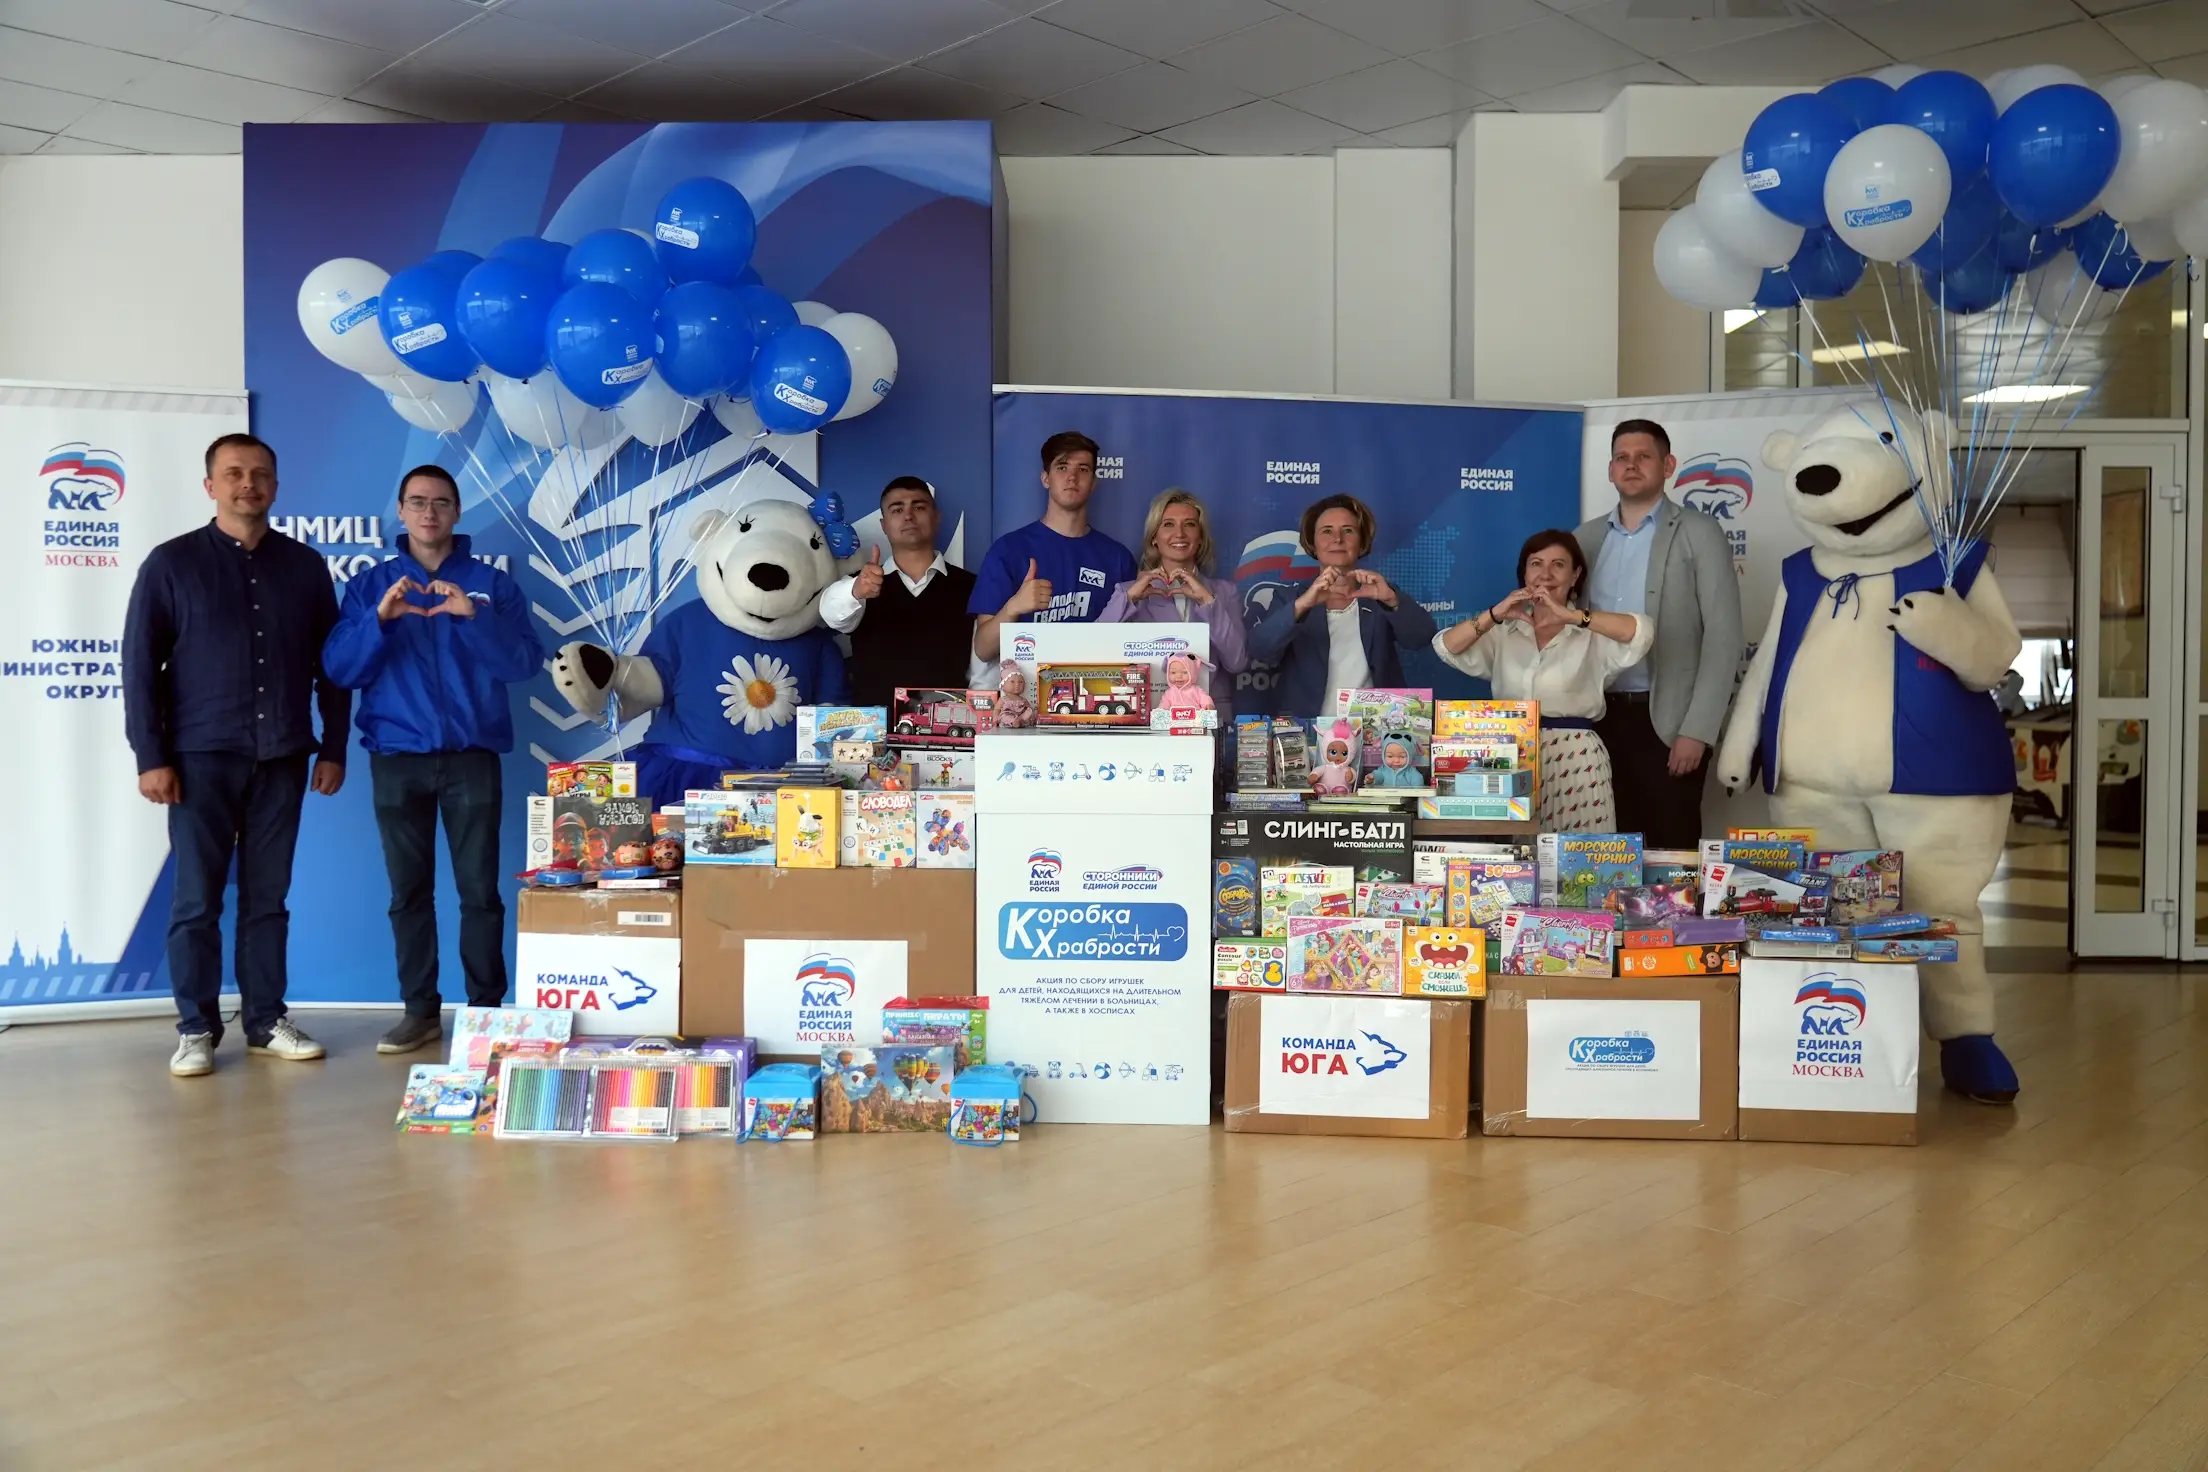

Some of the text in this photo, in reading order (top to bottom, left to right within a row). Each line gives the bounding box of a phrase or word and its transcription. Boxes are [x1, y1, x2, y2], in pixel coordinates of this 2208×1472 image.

[1846, 206, 1891, 226] Коробка
[1856, 212, 1904, 227] Храбрости
[776, 385, 815, 404] Коробка
[1096, 456, 1124, 467] НАЯ
[1266, 461, 1320, 473] ЕДИНАЯ
[1095, 468, 1124, 479] СИЯ
[1266, 473, 1320, 485] РОССИЯ
[1461, 467, 1514, 480] ЕДИНАЯ
[1461, 479, 1514, 491] РОССИЯ
[44, 520, 120, 534] ЕДИНАЯ
[44, 535, 120, 548] РОССИЯ
[45, 554, 120, 568] МОСКВА
[32, 639, 119, 653] ЮЖНЫ
[1124, 642, 1184, 650] СТОРОННИКИ
[1124, 650, 1175, 658] ЕДИНОЙ РОС
[0, 662, 123, 676] ИНИСТРА
[604, 802, 640, 815] ЗАМОК
[860, 795, 913, 811] СЛОВОДЕЛ
[598, 814, 645, 826] УЖАСОВ
[1264, 820, 1405, 839] СЛИНГ-БАТЛ
[1564, 839, 1627, 853] МОРСКОЙ
[1586, 853, 1637, 864] ТУРНИР
[1729, 848, 1789, 860] МОРСКОЙ
[1082, 871, 1159, 882] СТОРОННИКИ
[1485, 864, 1503, 878] 50
[1082, 882, 1120, 890] ЕДИНОЙ
[1005, 904, 1131, 949] Коробка
[1031, 928, 1161, 958] Храбрости
[536, 973, 609, 986] КОМАНДА
[1428, 971, 1463, 980] СКАЖИ,
[998, 987, 1017, 995] ДЛЯ
[1018, 986, 1045, 995] ДЕТЕЙ,
[1046, 987, 1111, 995] НАХОДЯЩИХСЯ
[1126, 988, 1182, 996] ДЛИТЕЛЬНОМ
[1422, 982, 1467, 992] СМОЖЕШЬ
[536, 988, 601, 1011] ЮГА
[1021, 996, 1061, 1004] ТЯЖЁЛОМ
[1107, 998, 1160, 1006] БОЛЬНИЦАХ,
[798, 1010, 853, 1020] ЕДИНАЯ
[923, 1012, 967, 1021] ПИРАТЫ
[798, 1021, 853, 1030] РОССИЯ
[796, 1032, 856, 1042] МОСКВА
[1282, 1037, 1357, 1050] КОМАНДА
[1572, 1039, 1630, 1058] Коробка
[1797, 1038, 1862, 1050] ЕДИНАЯ
[1583, 1048, 1643, 1062] Храбрости
[1796, 1051, 1861, 1064] РОССИЯ
[1282, 1052, 1349, 1075] ЮГА
[1792, 1064, 1864, 1078] МОСКВА
